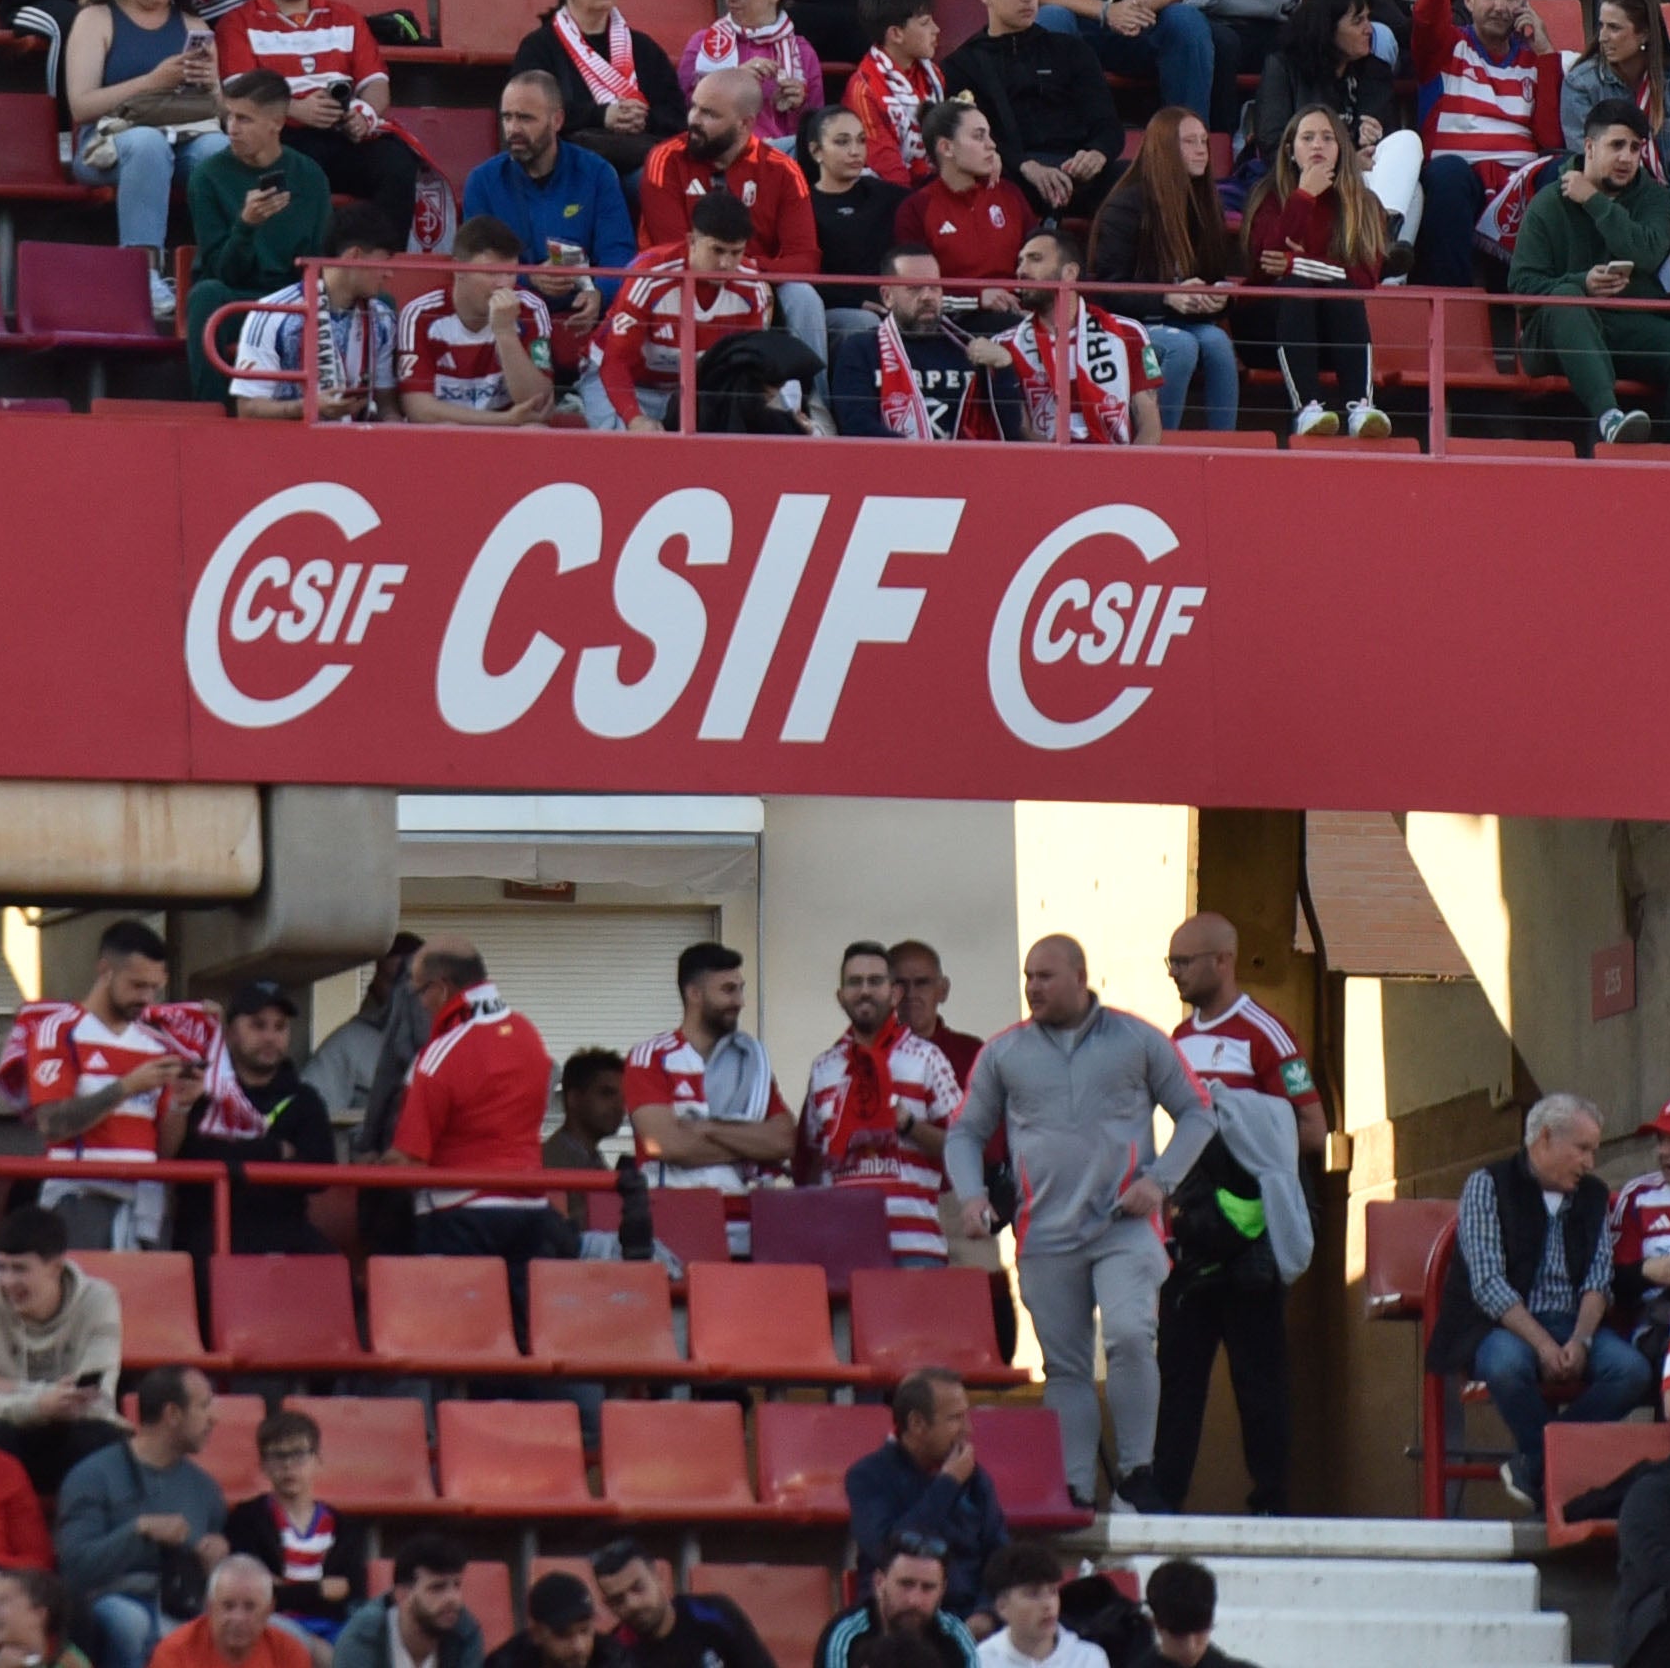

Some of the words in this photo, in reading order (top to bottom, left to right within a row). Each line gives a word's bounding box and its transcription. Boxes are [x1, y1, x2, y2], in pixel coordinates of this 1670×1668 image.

[230, 557, 408, 645] CSIF
[435, 482, 967, 743] CSIF
[1031, 579, 1207, 667] CSIF
